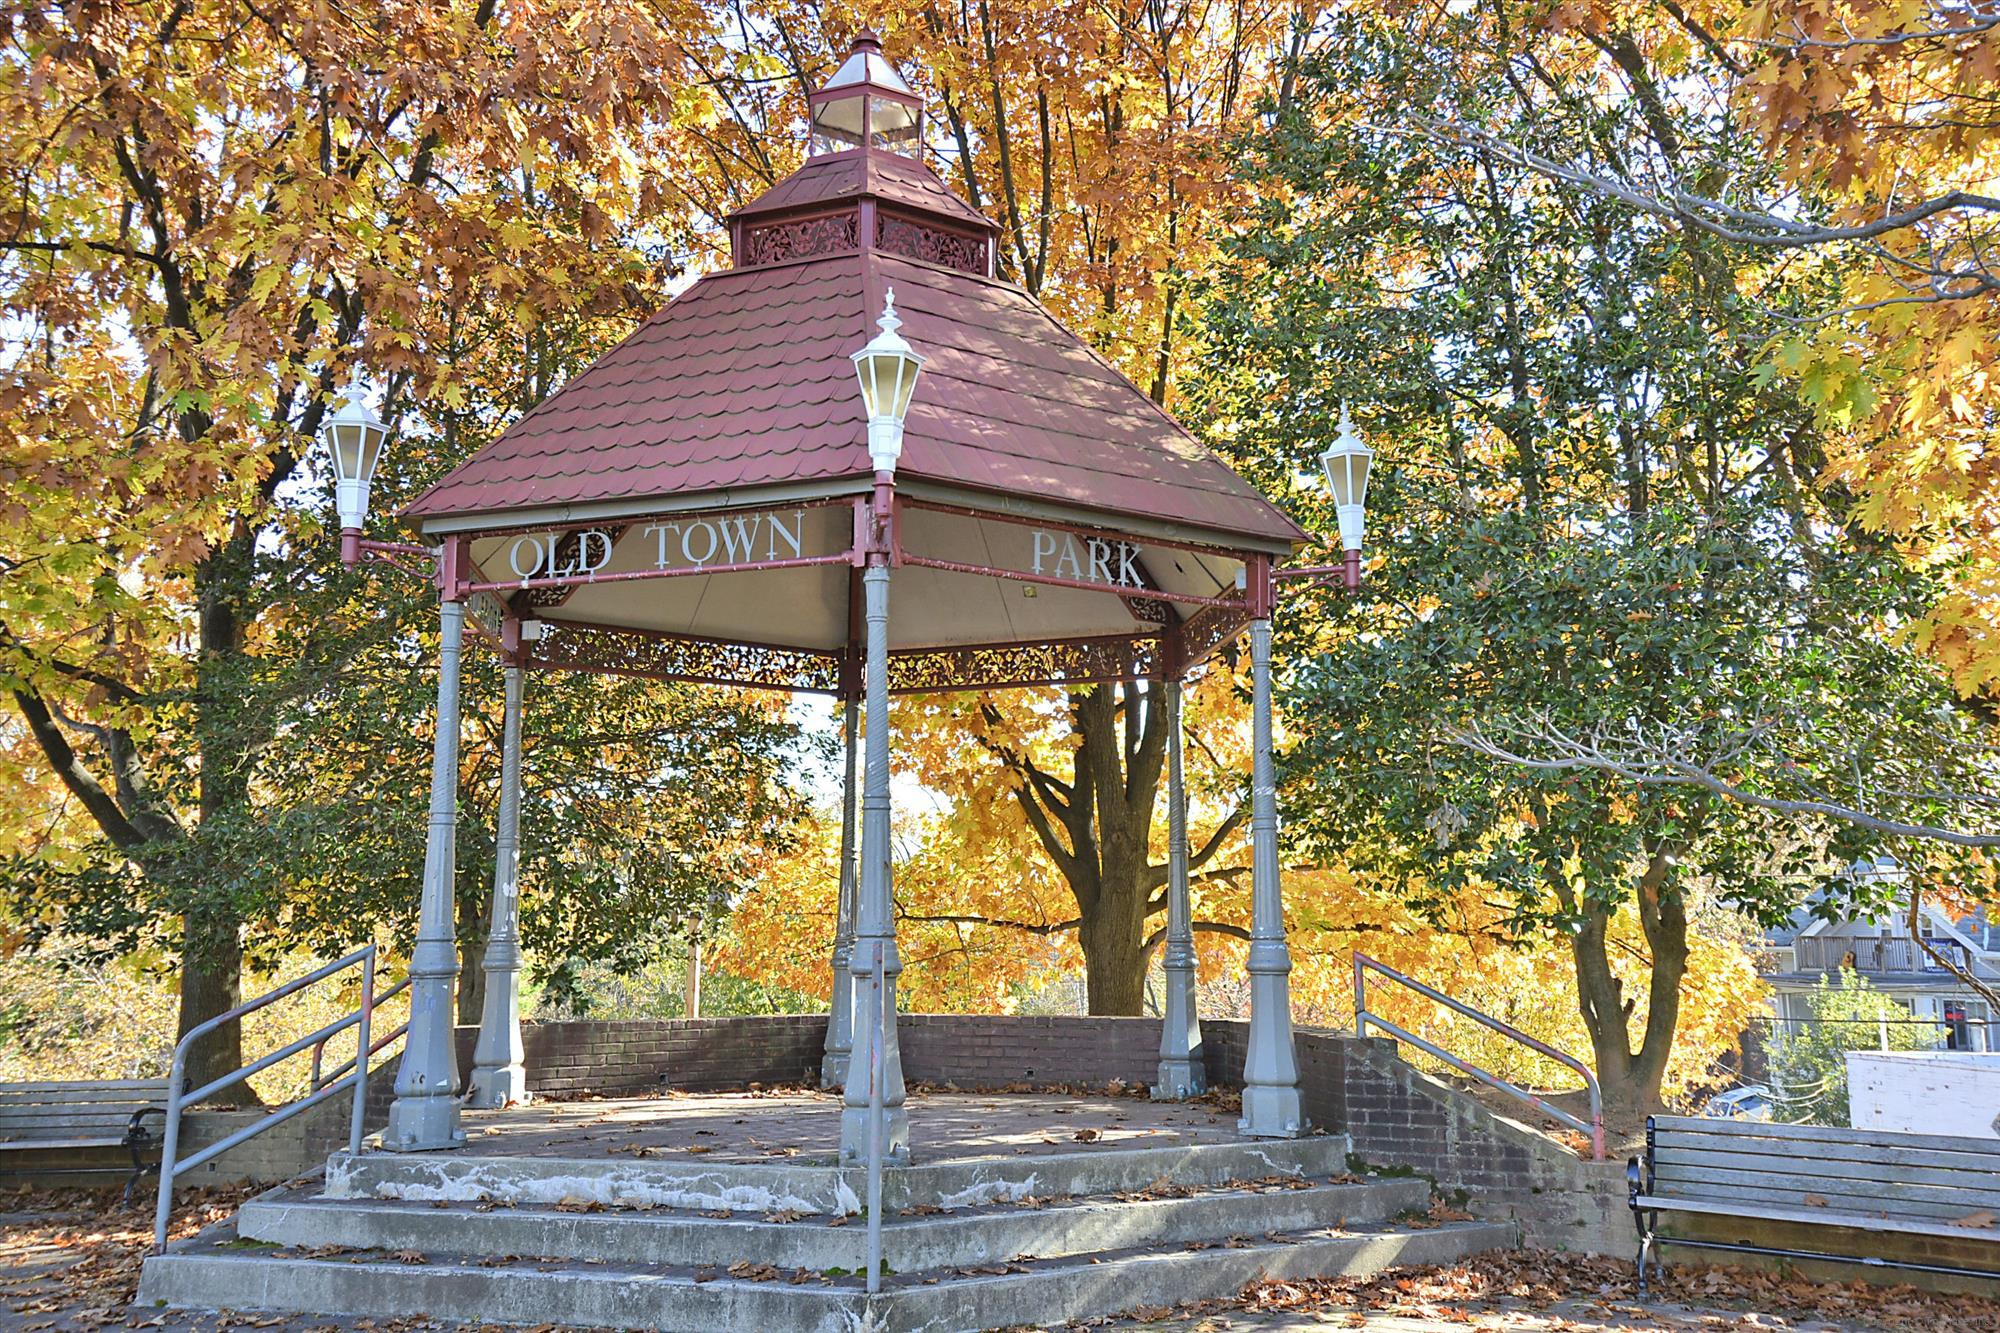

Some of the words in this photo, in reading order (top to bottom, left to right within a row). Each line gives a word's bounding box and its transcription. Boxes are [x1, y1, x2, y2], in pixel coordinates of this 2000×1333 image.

[510, 531, 613, 579] OLD
[644, 511, 806, 569] TOWN
[1031, 530, 1144, 588] PARK
